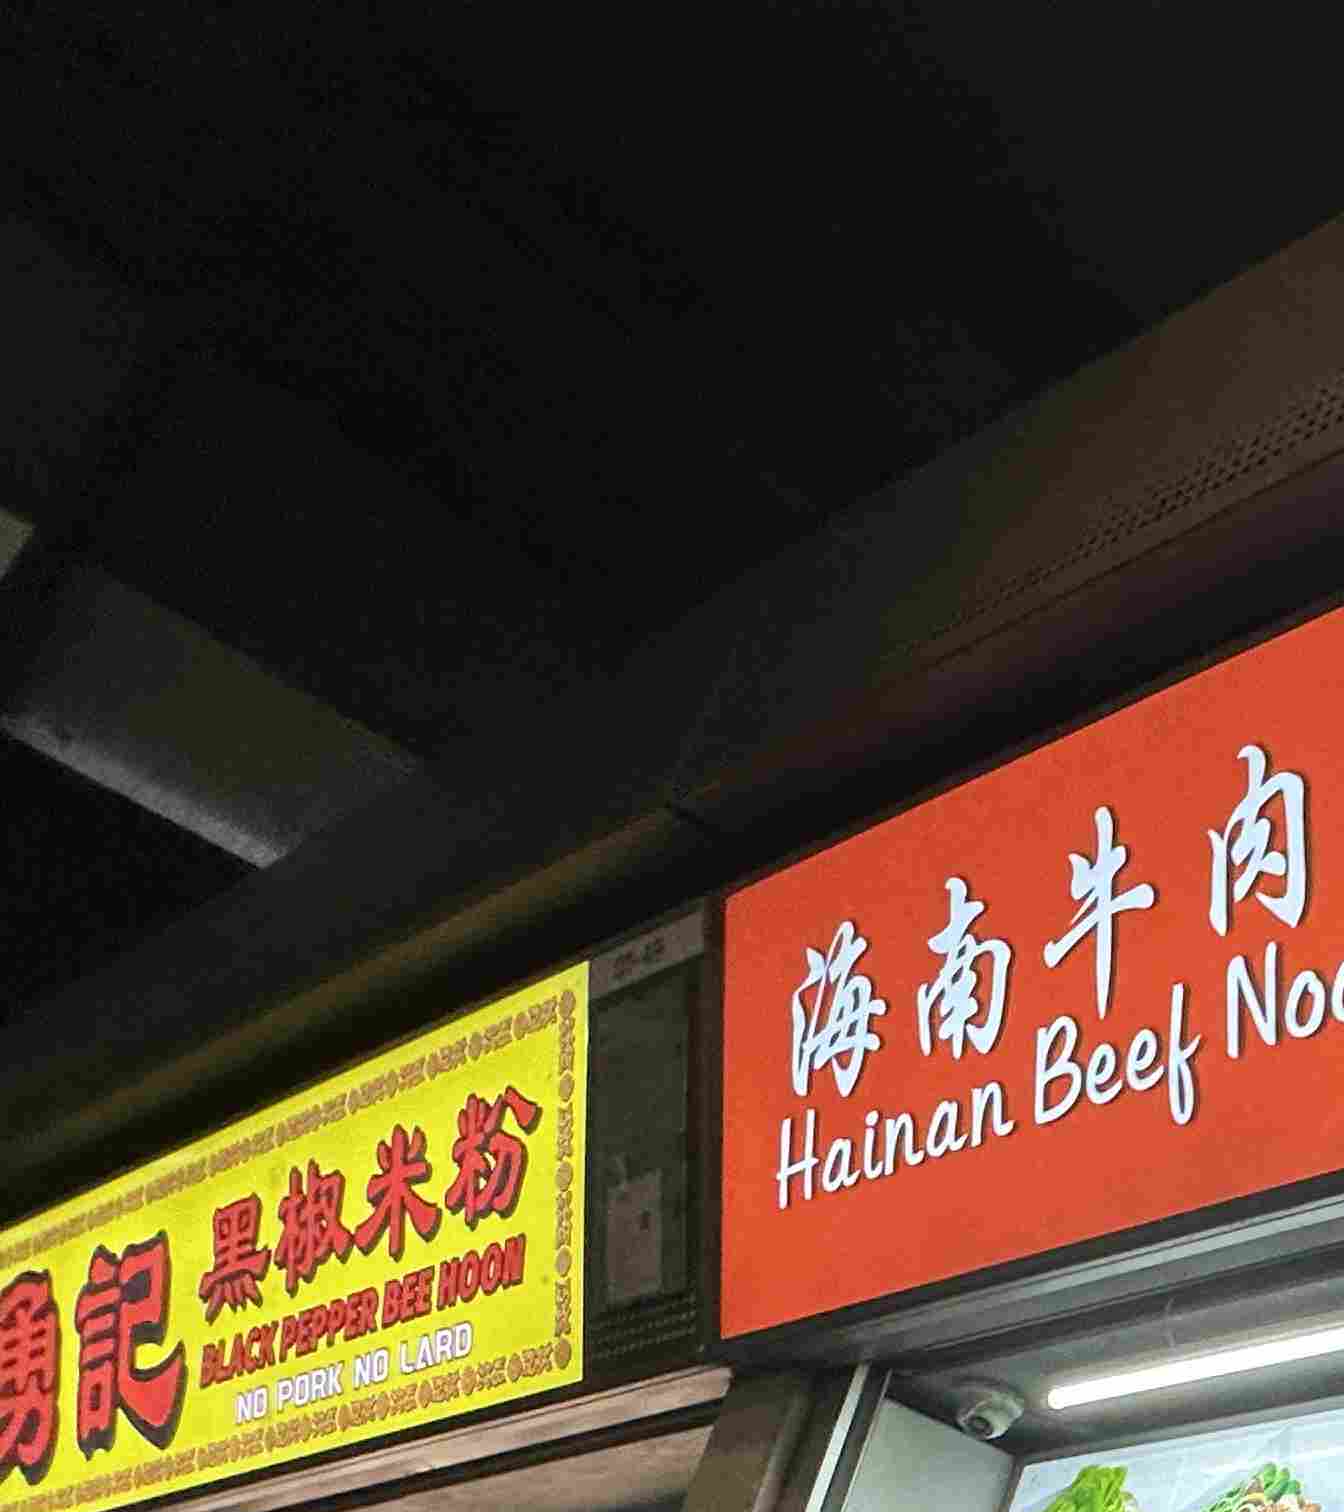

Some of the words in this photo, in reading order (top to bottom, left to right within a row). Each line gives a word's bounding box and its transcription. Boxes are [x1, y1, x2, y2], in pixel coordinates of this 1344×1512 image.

[776, 1081, 1014, 1209] Hainan
[1033, 983, 1201, 1125] Beef
[199, 1085, 543, 1322] 黑椒米粉
[200, 1320, 278, 1388] BLACK
[279, 1287, 378, 1363] PEPPER
[382, 1266, 435, 1329] BEE
[436, 1233, 526, 1310] HOON
[235, 1385, 268, 1424] NO
[276, 1361, 344, 1412] PORK
[353, 1348, 388, 1389] NO
[400, 1322, 473, 1374] LARD
